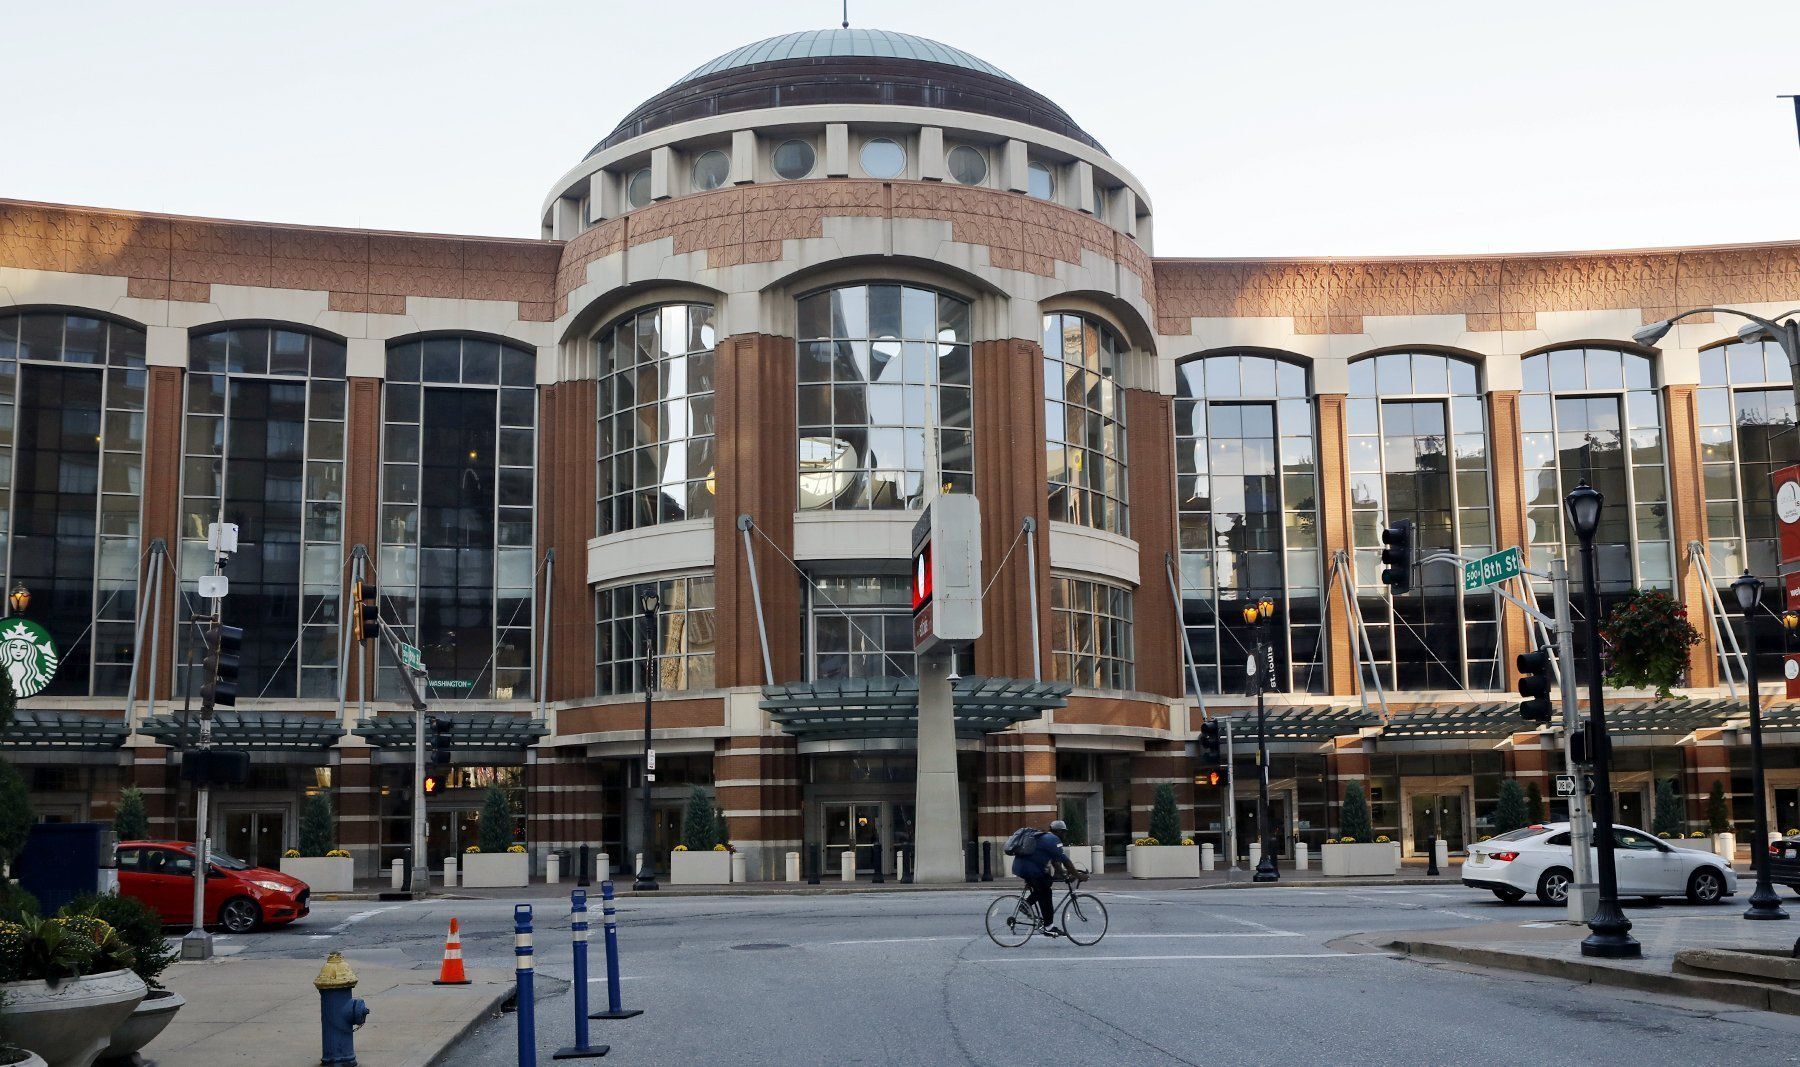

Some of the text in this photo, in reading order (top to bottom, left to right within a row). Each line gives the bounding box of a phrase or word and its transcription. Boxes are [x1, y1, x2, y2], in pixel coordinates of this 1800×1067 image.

[1483, 554, 1518, 579] 8th St
[1267, 646, 1275, 673] louis
[428, 680, 467, 688] WASHINGTON
